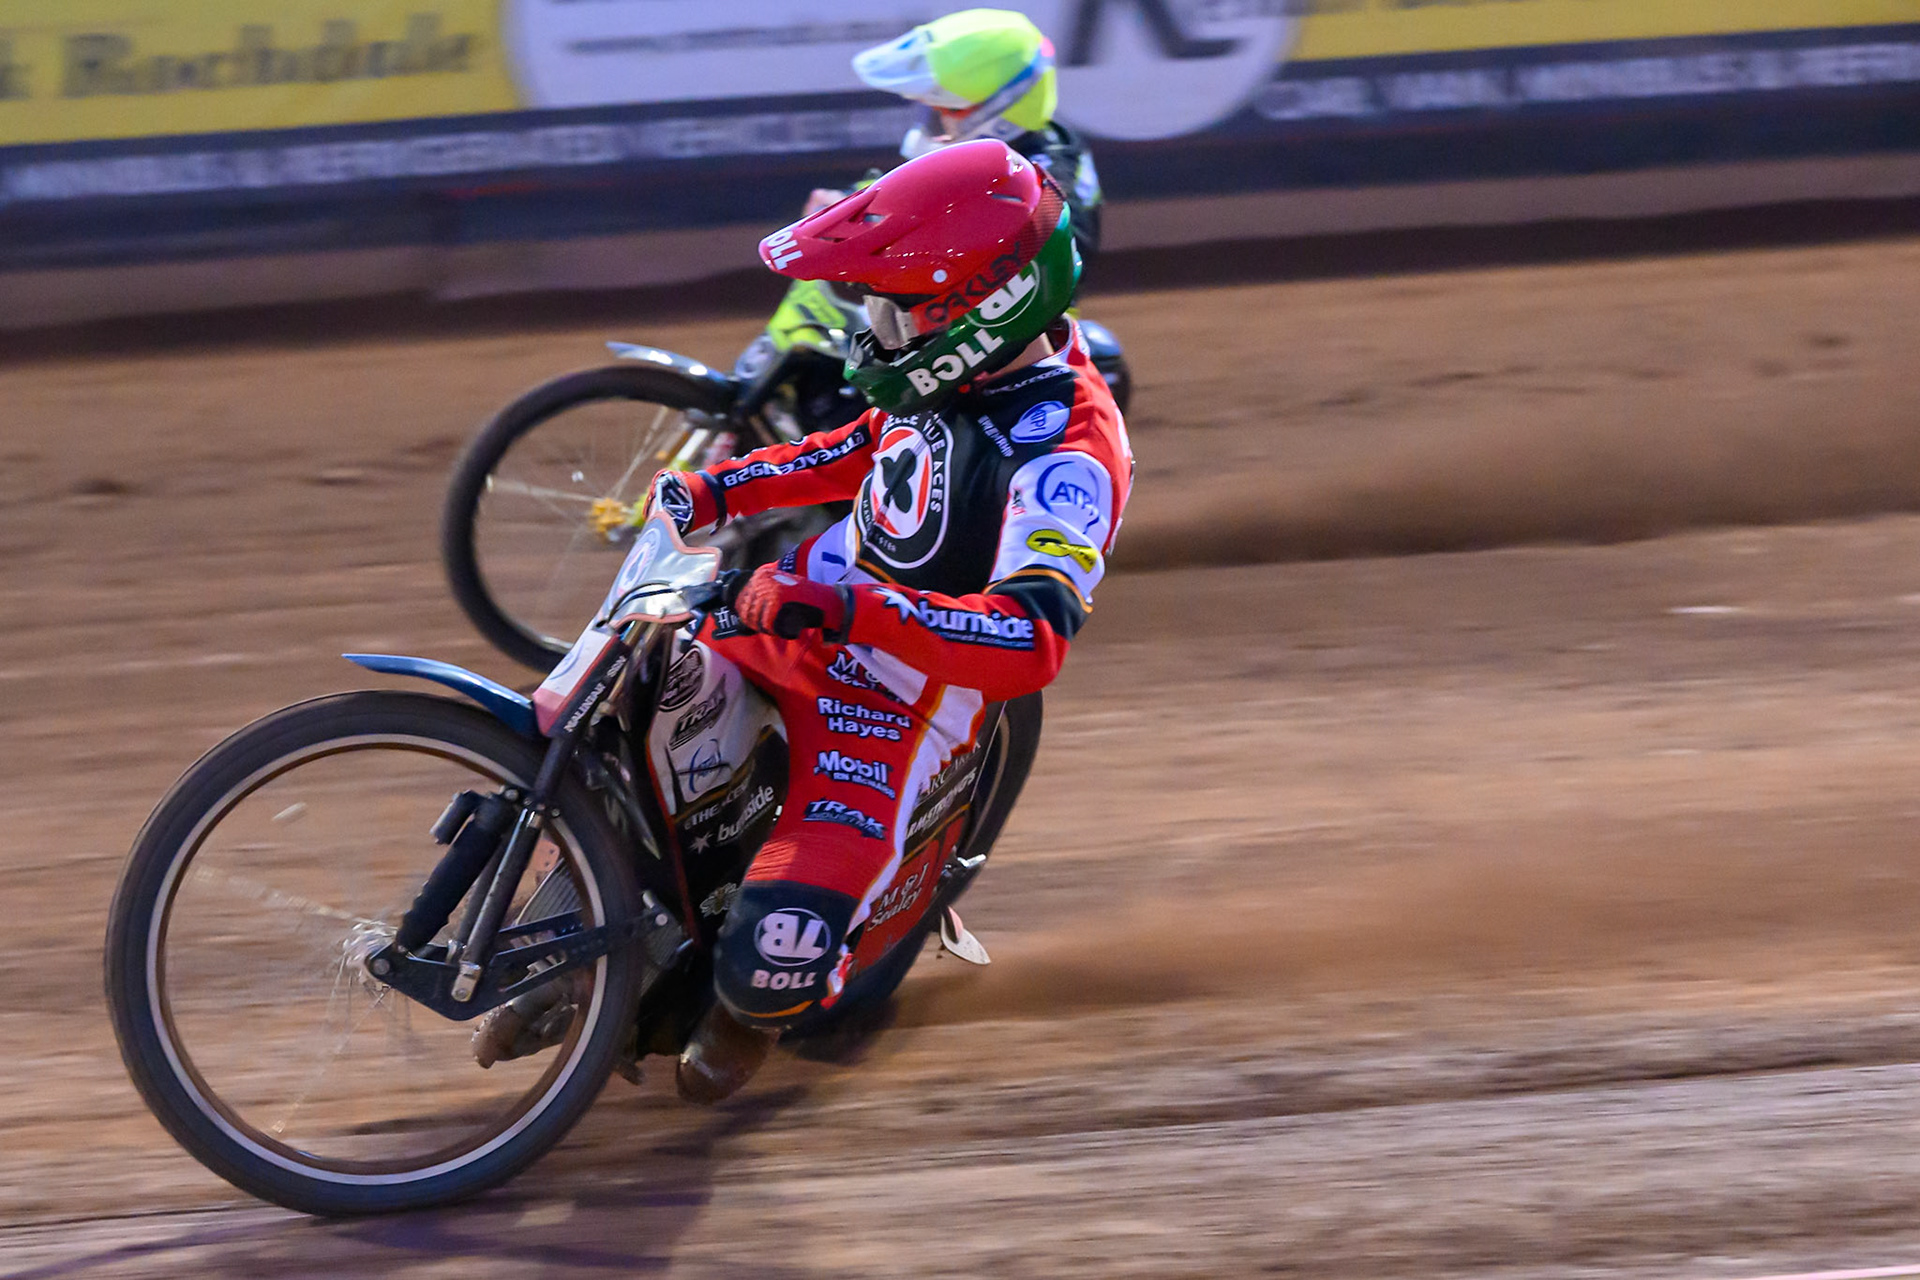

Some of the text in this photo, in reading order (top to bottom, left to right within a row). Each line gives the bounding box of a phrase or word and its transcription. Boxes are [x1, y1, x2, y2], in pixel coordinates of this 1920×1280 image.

[767, 230, 803, 270] OLL
[925, 241, 1022, 323] OAKLEY
[906, 328, 1005, 397] BOLL
[930, 461, 944, 513] ACES
[817, 697, 911, 729] Richard
[828, 717, 901, 741] Hayes
[718, 785, 774, 841] buside
[752, 969, 817, 990] BOLL
